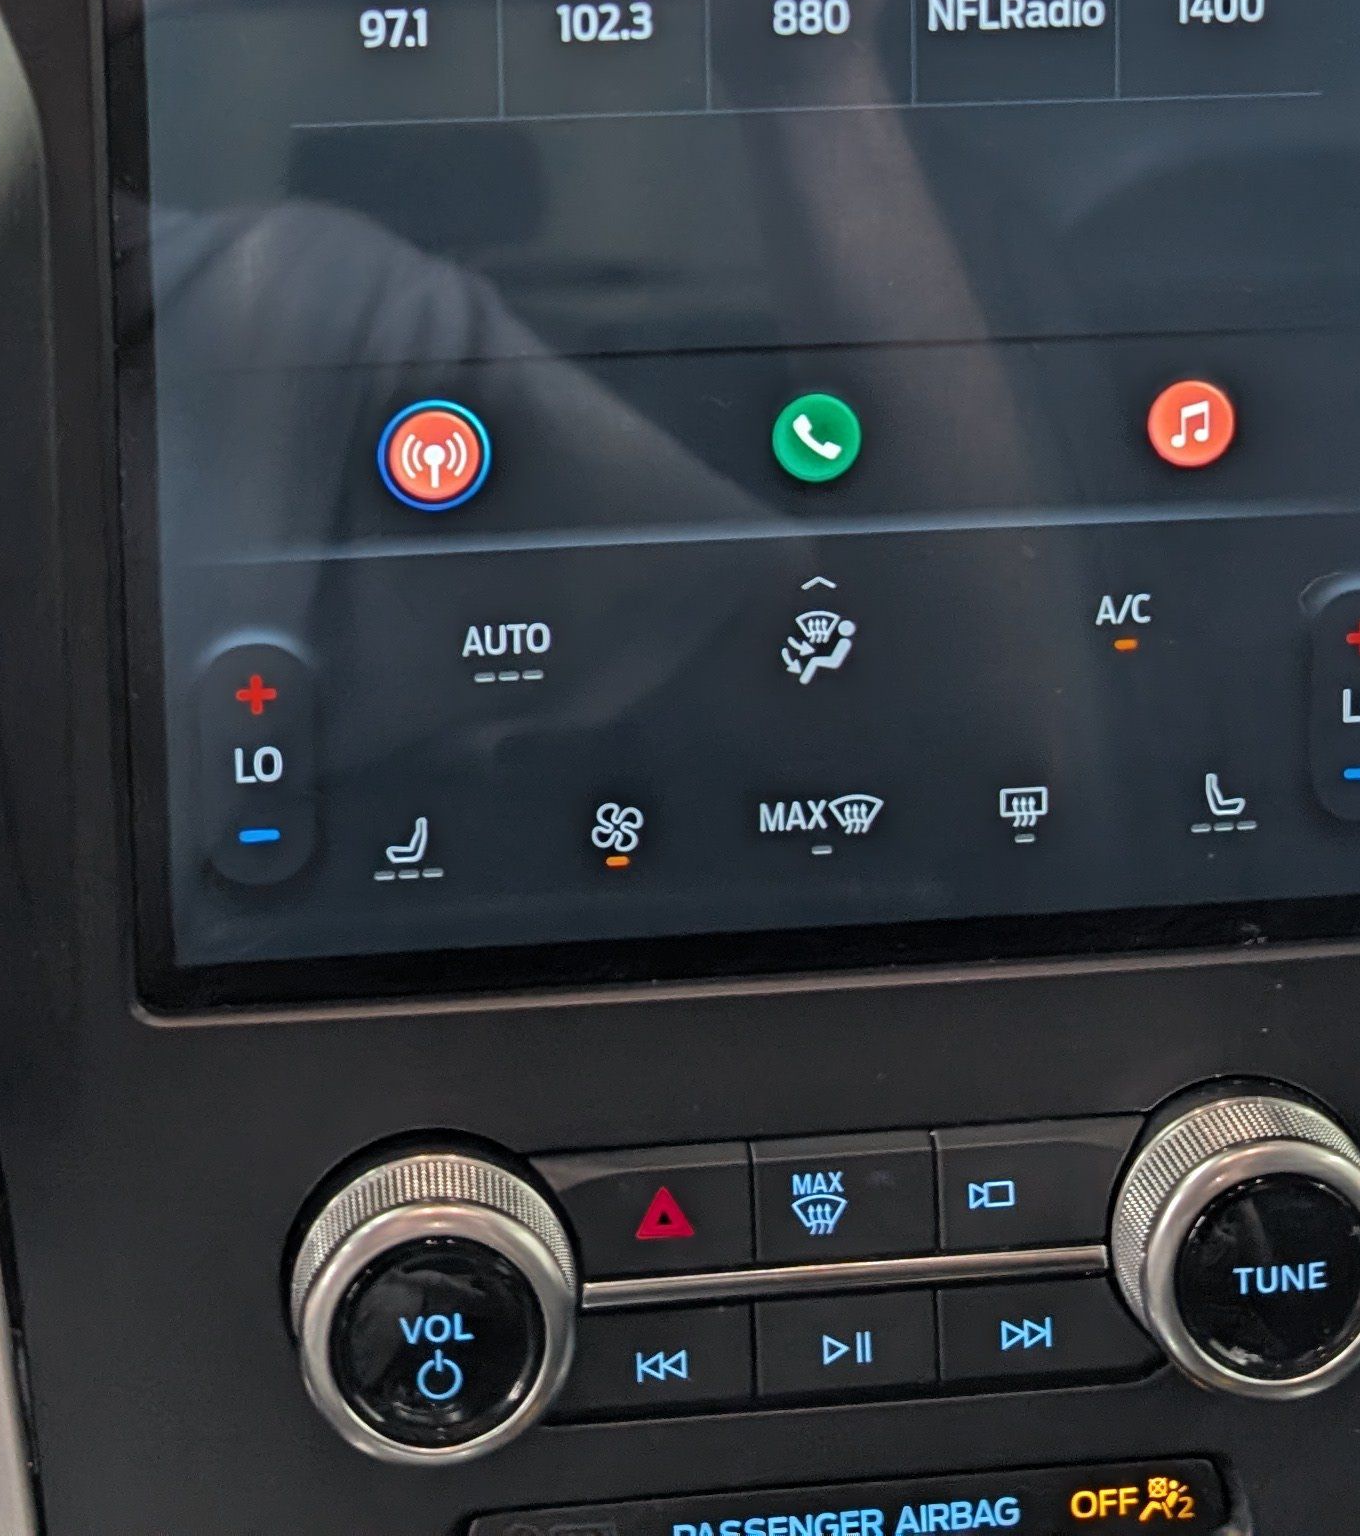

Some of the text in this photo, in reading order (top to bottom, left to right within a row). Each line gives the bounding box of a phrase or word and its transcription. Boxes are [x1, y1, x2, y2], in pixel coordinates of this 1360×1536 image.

[359, 8, 428, 48] 97.1
[556, 1, 653, 43] 102.3
[1096, 593, 1152, 626] A/C
[462, 622, 551, 657] AUTO
[234, 746, 283, 784] LO
[759, 799, 827, 833] MAX
[792, 1171, 845, 1195] MAX
[1233, 1261, 1327, 1295] TUNE
[400, 1312, 474, 1345] VOL
[895, 1497, 1021, 1536] AIRBAG
[1070, 1486, 1139, 1519] OFF
